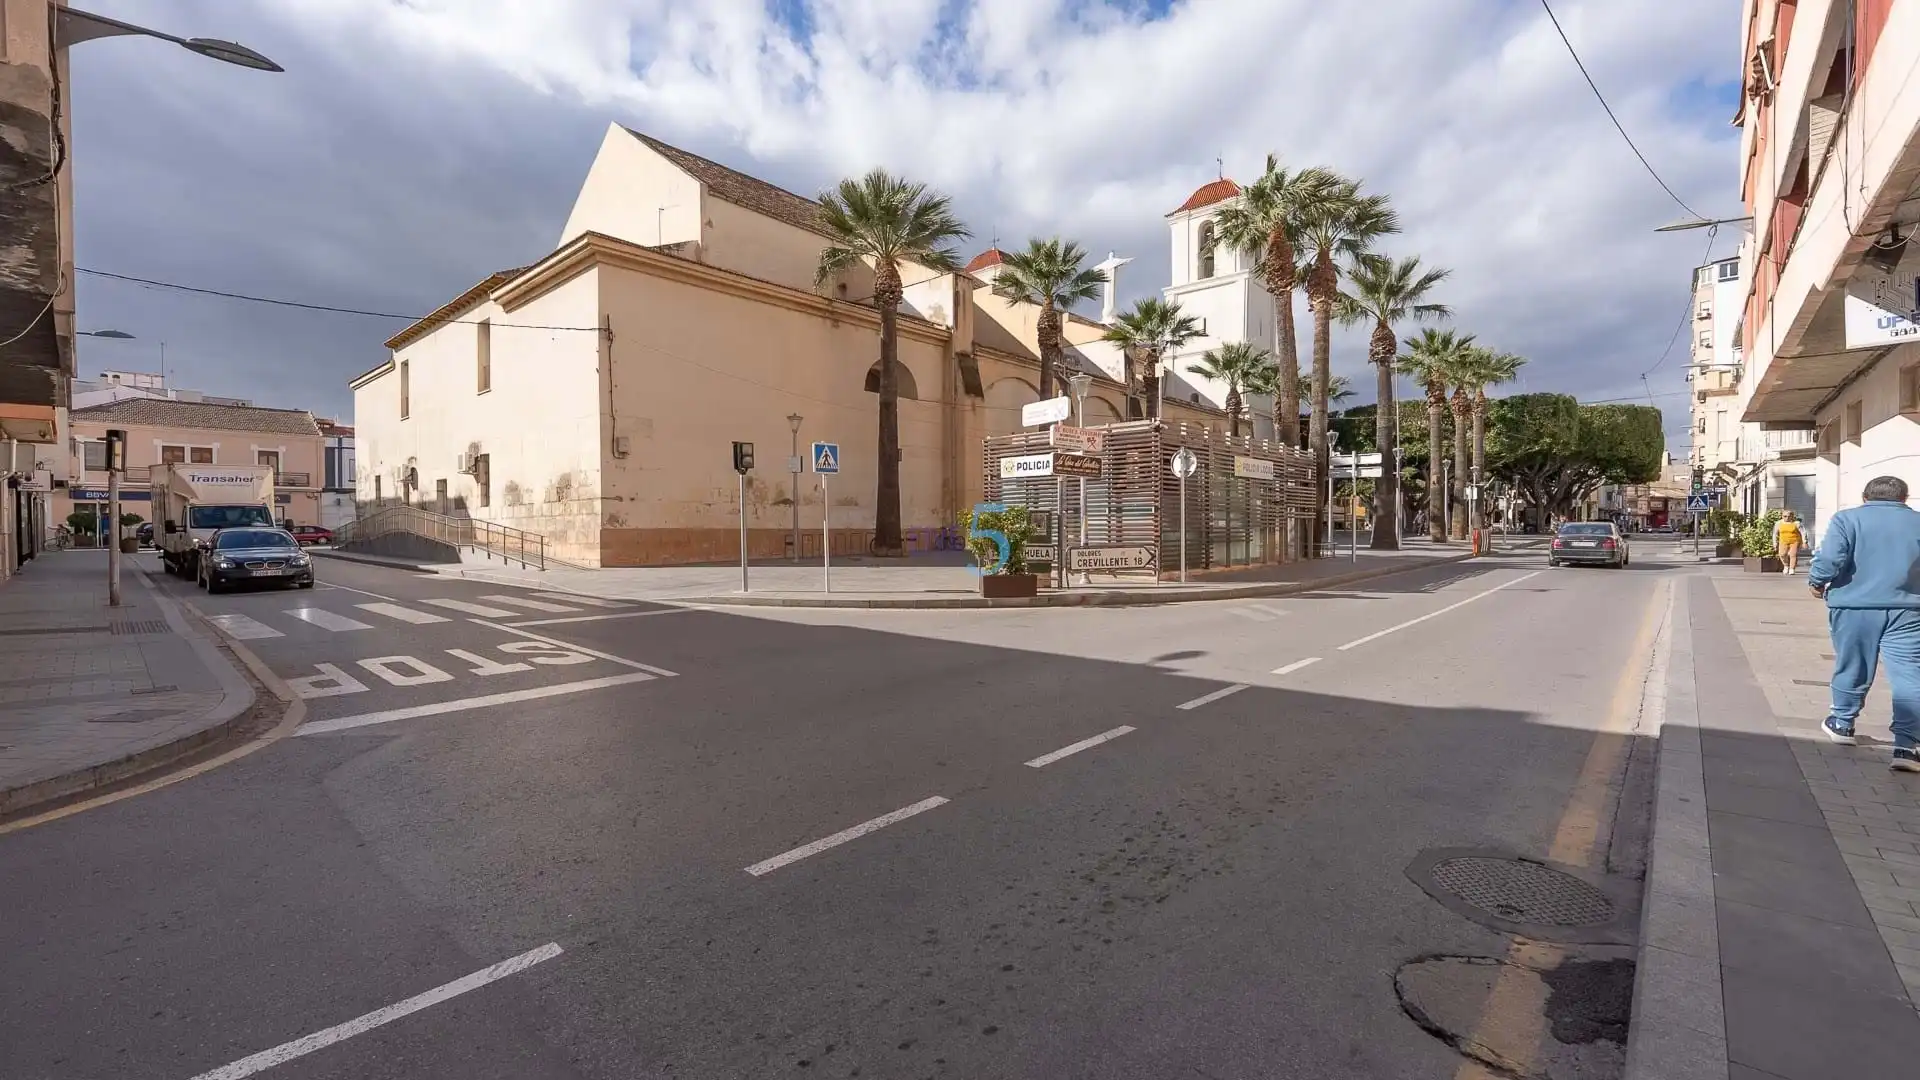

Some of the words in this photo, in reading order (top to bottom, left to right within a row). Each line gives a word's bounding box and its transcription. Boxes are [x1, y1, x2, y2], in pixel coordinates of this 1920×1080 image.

[1877, 316, 1905, 329] UP
[1016, 460, 1051, 472] POLICIA
[188, 474, 255, 483] Transaher
[1077, 557, 1129, 568] CREVILLENTE
[1133, 557, 1143, 566] 18
[287, 641, 597, 699] STOP
